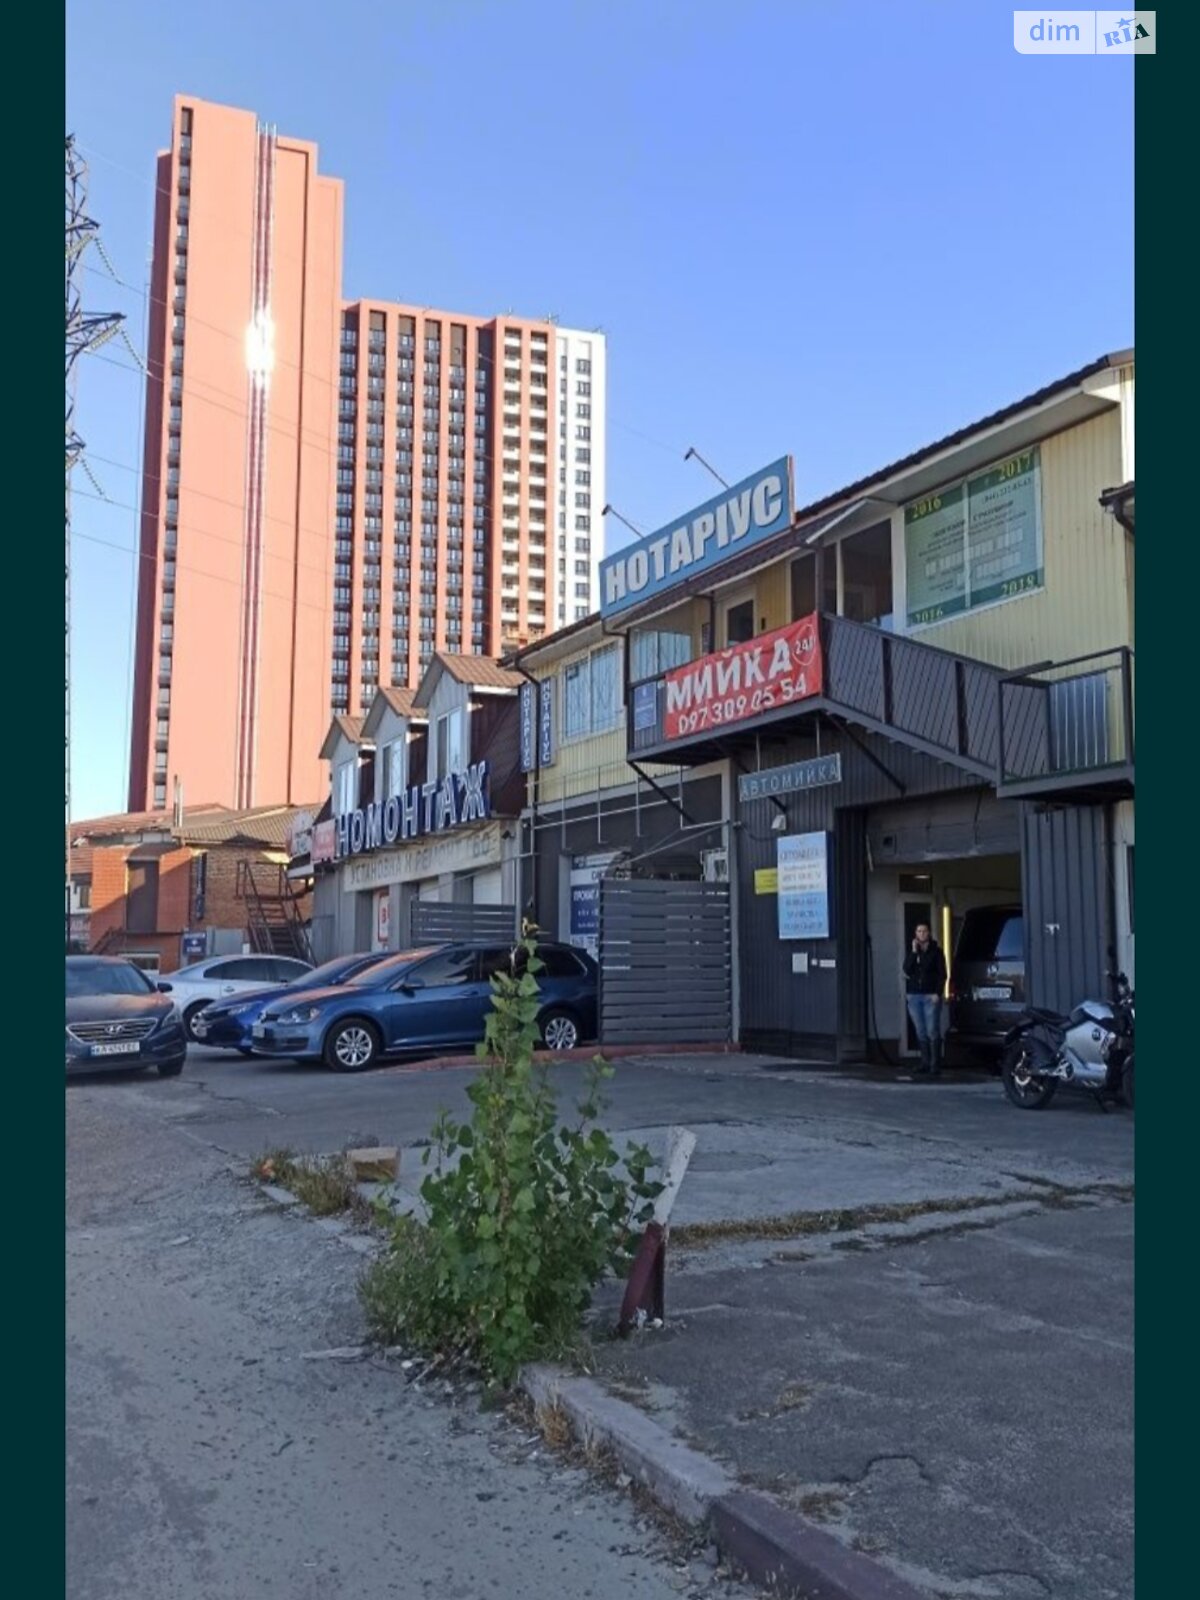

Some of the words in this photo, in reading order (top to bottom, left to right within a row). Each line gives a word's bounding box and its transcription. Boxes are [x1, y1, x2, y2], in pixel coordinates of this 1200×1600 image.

[606, 475, 782, 605] НОТАРІУС
[912, 495, 942, 519] 2016
[1001, 574, 1035, 596] 2018
[666, 637, 792, 714] МИЙКА
[678, 706, 707, 735] 097
[711, 695, 747, 724] 309
[751, 686, 775, 711] 05
[780, 673, 807, 701] 54
[523, 686, 531, 767] НОТАРІУС
[336, 760, 487, 859] НОМОНТАЖ
